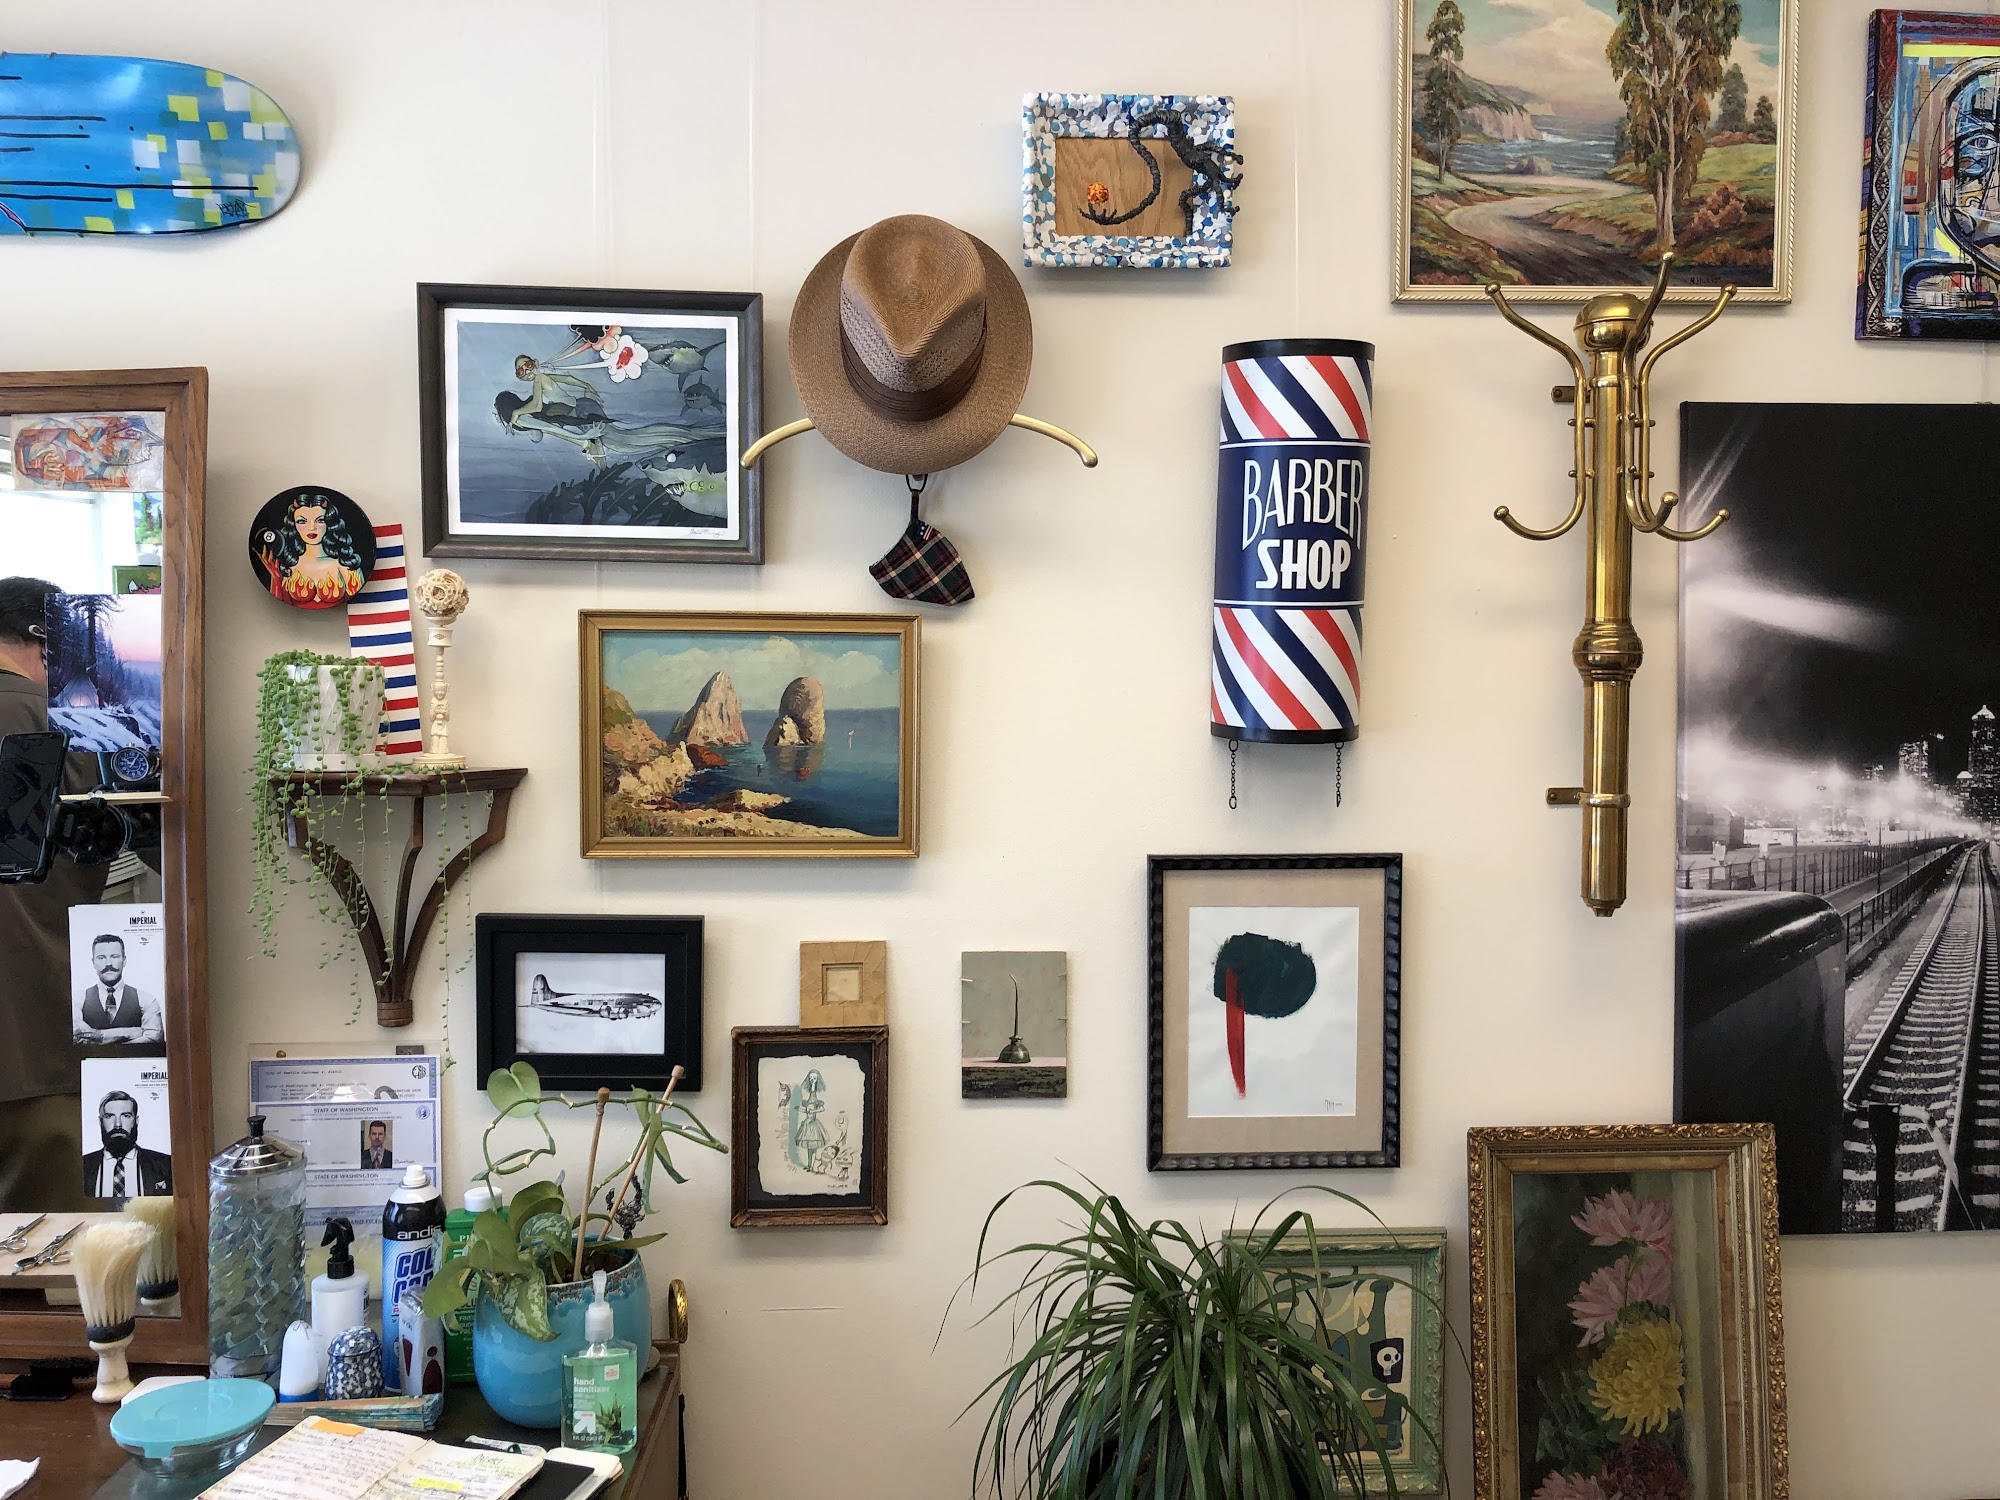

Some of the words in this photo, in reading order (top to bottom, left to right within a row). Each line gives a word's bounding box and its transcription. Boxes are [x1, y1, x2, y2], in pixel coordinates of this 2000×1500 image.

[1242, 458, 1363, 551] BARBER
[265, 532, 273, 541] 8
[1255, 539, 1352, 590] SHOP
[129, 916, 157, 925] IMPERIAL
[140, 1072, 168, 1081] IMPERIAL
[396, 1246, 434, 1278] CO
[573, 1377, 595, 1386] hand
[573, 1385, 610, 1393] sanitizer
